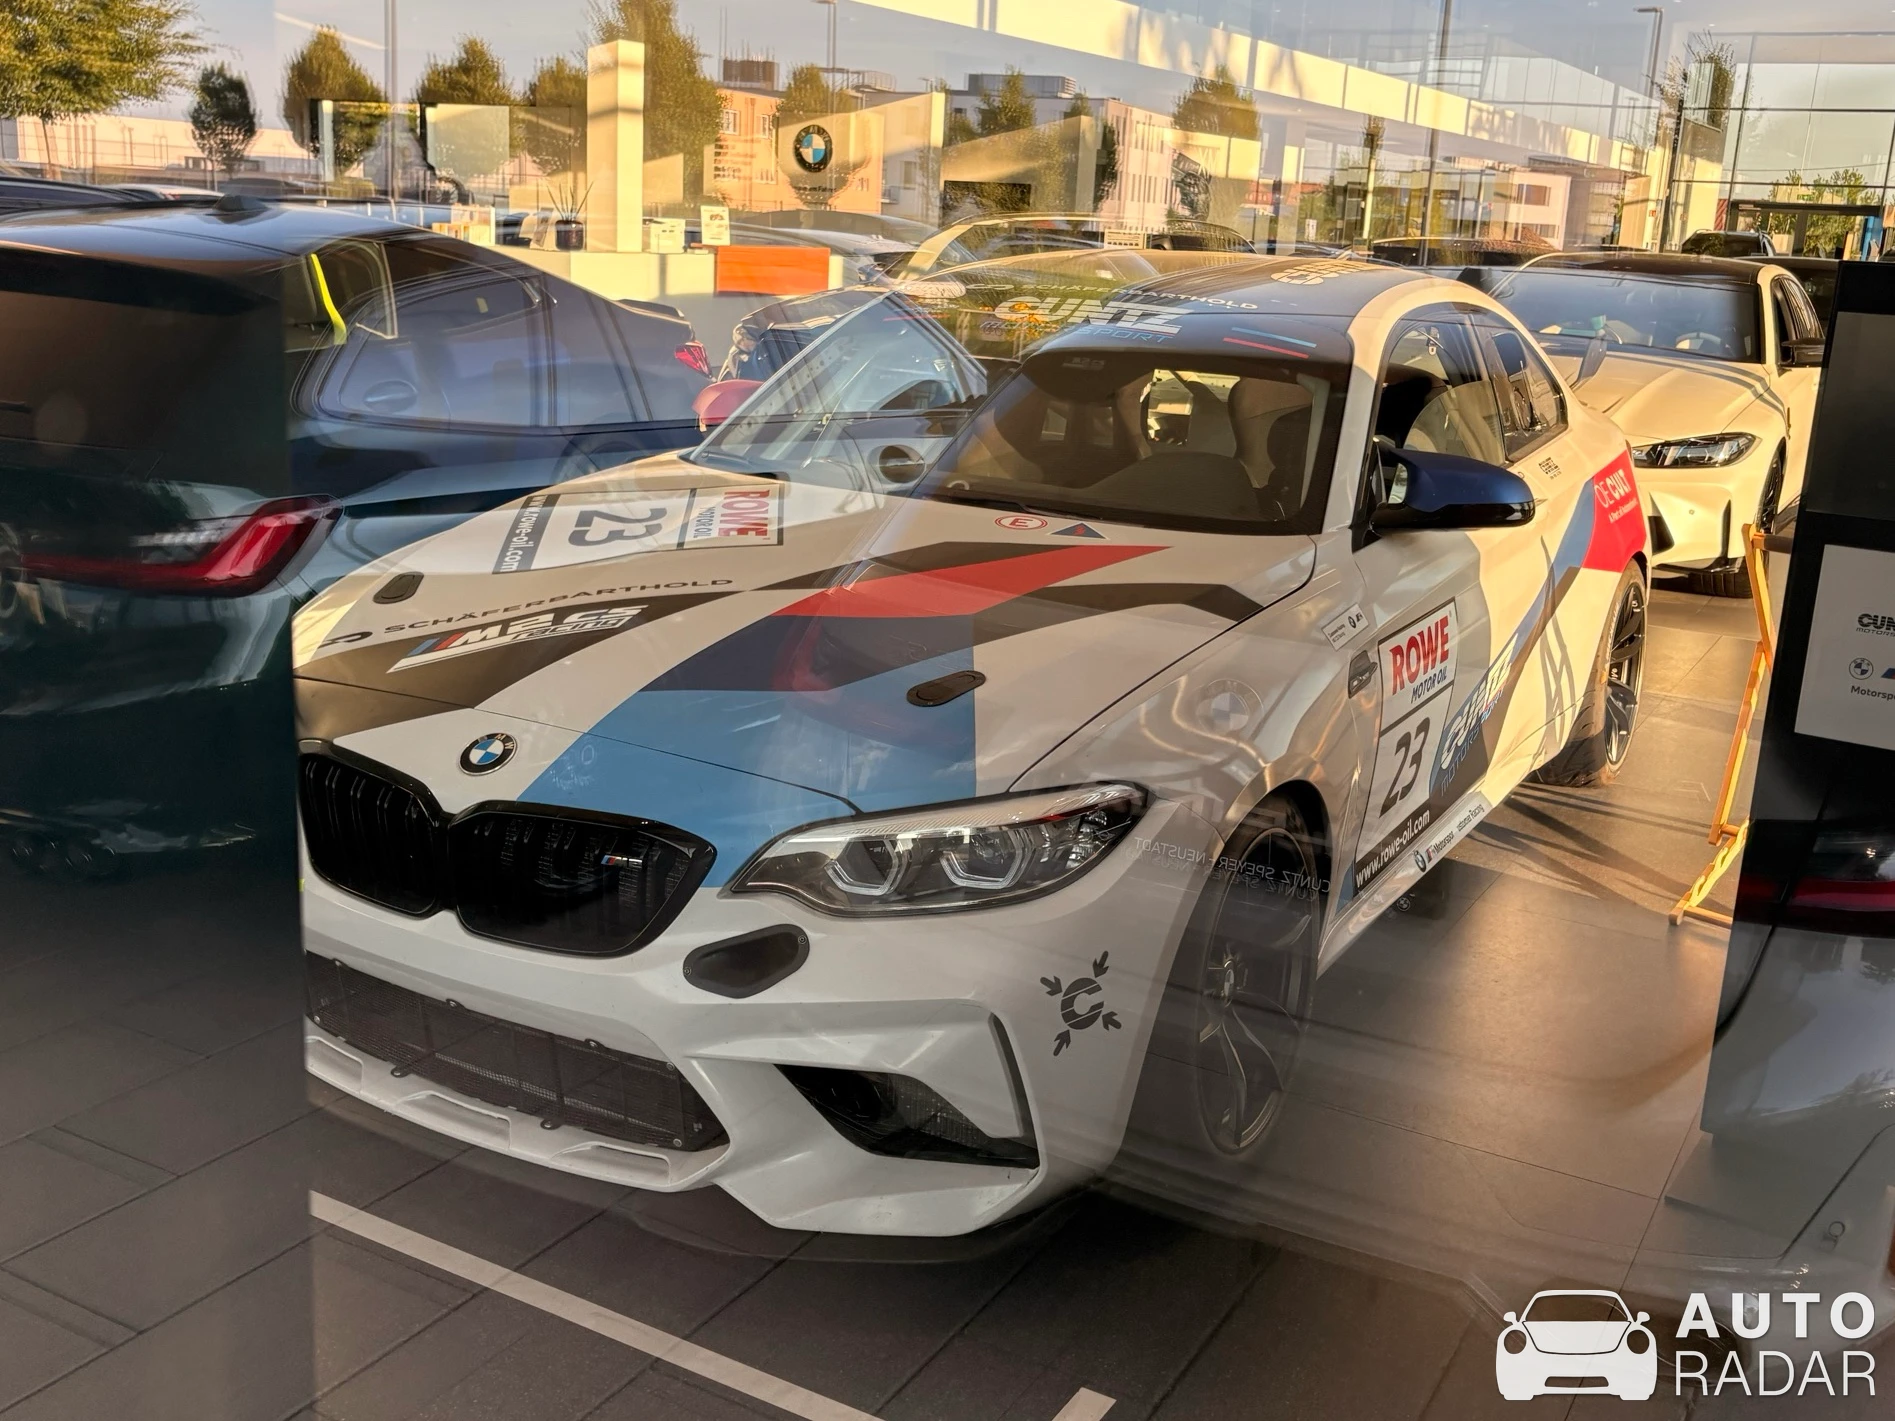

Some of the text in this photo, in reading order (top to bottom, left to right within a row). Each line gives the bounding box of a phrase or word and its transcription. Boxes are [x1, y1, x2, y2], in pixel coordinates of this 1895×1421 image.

[994, 296, 1195, 336] CUNTZ
[500, 494, 548, 572] www.rowe-oil.com
[568, 507, 668, 547] 23
[693, 506, 717, 539] MOTOR OIL
[717, 489, 770, 538] ROWE
[384, 578, 733, 634] SCHÄFERBARTHOLD
[1388, 614, 1450, 696] ROWE
[1410, 665, 1449, 704] MOTOR OIL
[1378, 716, 1431, 819] 23
[1356, 809, 1431, 889] www.rowe-oil.com
